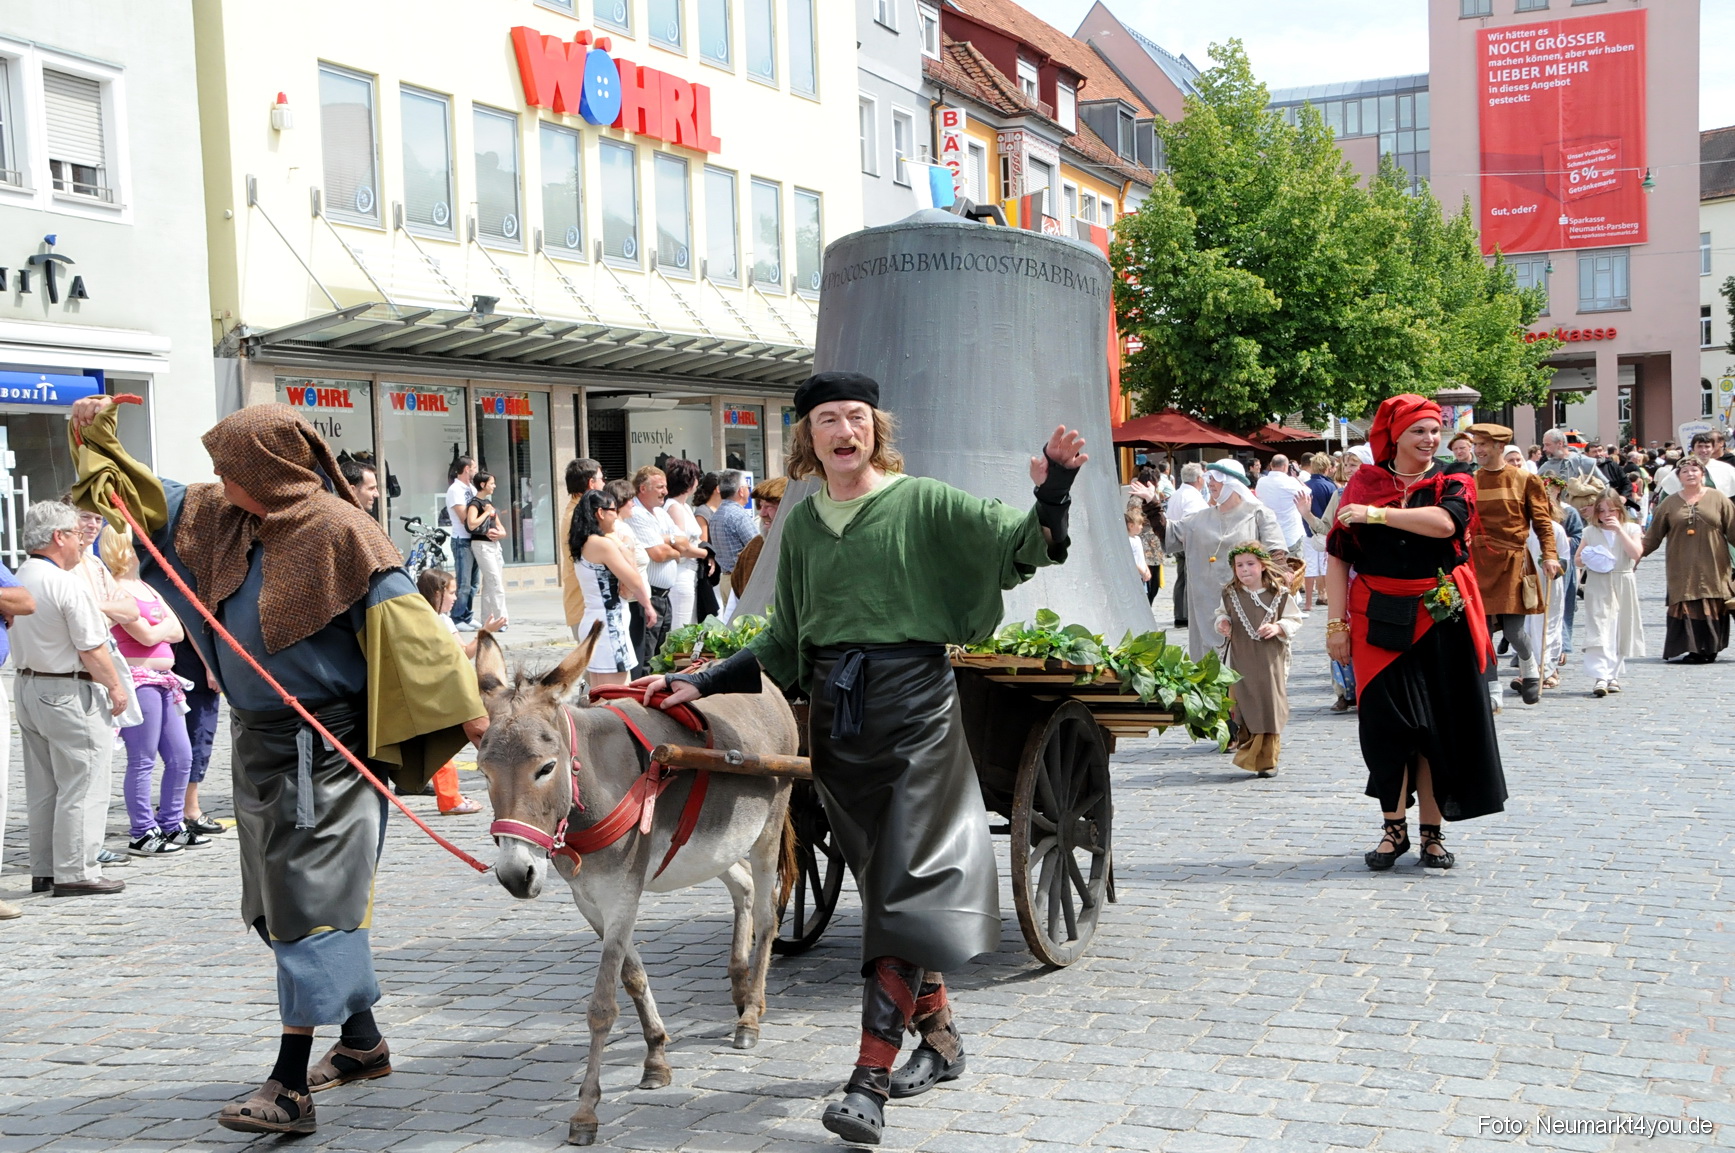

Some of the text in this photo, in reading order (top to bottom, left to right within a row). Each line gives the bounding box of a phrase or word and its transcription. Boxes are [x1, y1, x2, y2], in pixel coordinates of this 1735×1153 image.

[1487, 27, 1549, 42] Wir hätten es
[1488, 31, 1606, 56] NOCH GRÖSSER
[1488, 43, 1635, 67] machen können, aber wir haben
[1489, 60, 1589, 83] LIEBER MEHR
[511, 26, 721, 154] WÖHRL
[1488, 77, 1571, 94] in dieses Angebot
[1489, 94, 1531, 107] gesteckt:
[1584, 147, 1611, 157] Volksfest-
[1566, 158, 1599, 169] Schmankerl
[1569, 165, 1615, 184] 6 % und
[1568, 178, 1617, 195] Getränkemarke
[1491, 204, 1538, 217] Gut, oder?
[1568, 216, 1606, 226] Sparkasse
[1569, 222, 1640, 234] Neumarkt-Parsberg
[1569, 229, 1639, 240] www.sparkasse-neumarkt.de
[0, 375, 58, 402] BONITA
[286, 382, 354, 408] WÖHRL
[389, 387, 449, 412] WÖHRL
[481, 392, 534, 416] WÖHRL
[631, 427, 673, 449] newstyle
